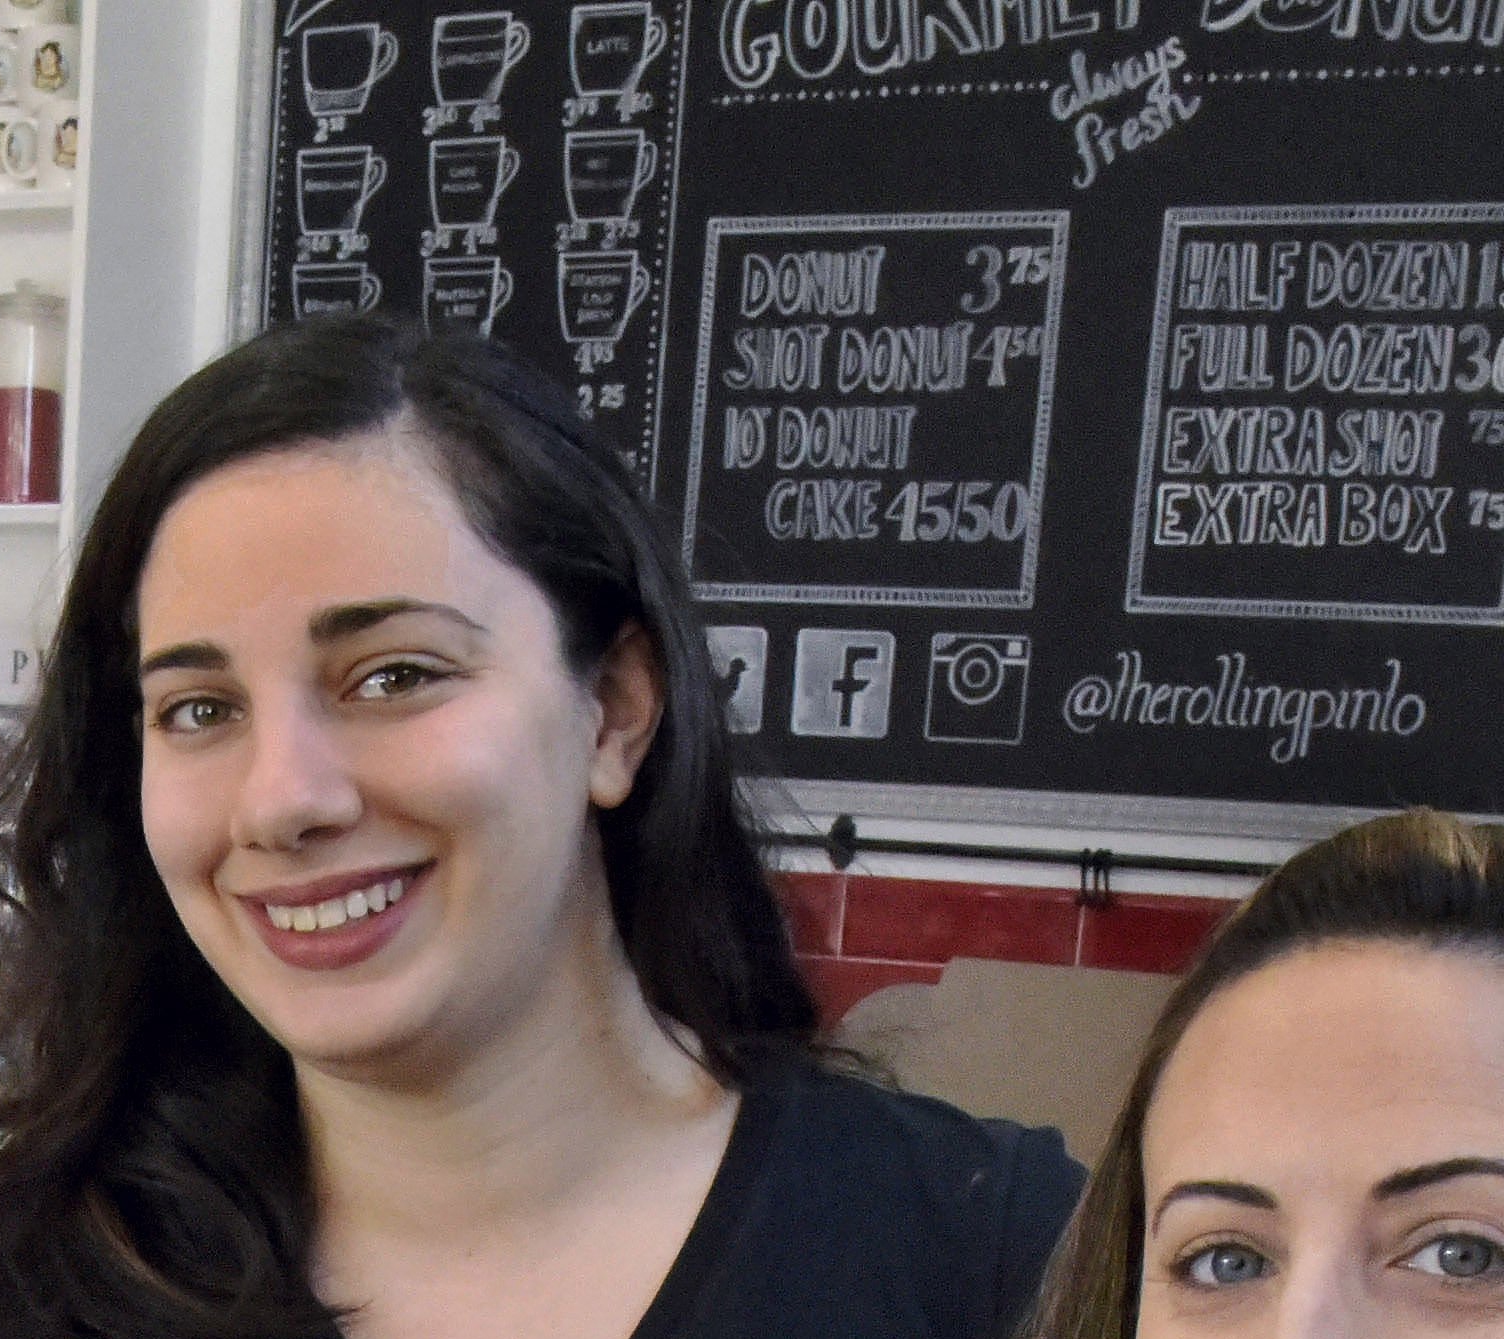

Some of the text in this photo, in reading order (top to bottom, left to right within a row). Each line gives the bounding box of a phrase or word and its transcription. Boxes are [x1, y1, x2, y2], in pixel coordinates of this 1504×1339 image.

[586, 37, 631, 55] LATTE
[1050, 36, 1187, 121] always
[1072, 82, 1202, 189] fresh
[740, 245, 887, 318] DONUT
[1179, 239, 1302, 311] HALF
[1306, 240, 1471, 311] DOZEN
[722, 323, 830, 391] SHOT
[837, 319, 975, 393] DONUT
[1169, 323, 1275, 393] FULL
[1284, 323, 1456, 395] DOZEN
[776, 405, 918, 471] DONUT
[1162, 406, 1326, 477] EXTRA
[1327, 406, 1446, 479] SHOT
[764, 478, 883, 542] CAKE
[1153, 481, 1328, 547] EXTRA
[1337, 481, 1455, 555] BOX
[1063, 650, 1428, 765] @therollingpinto
